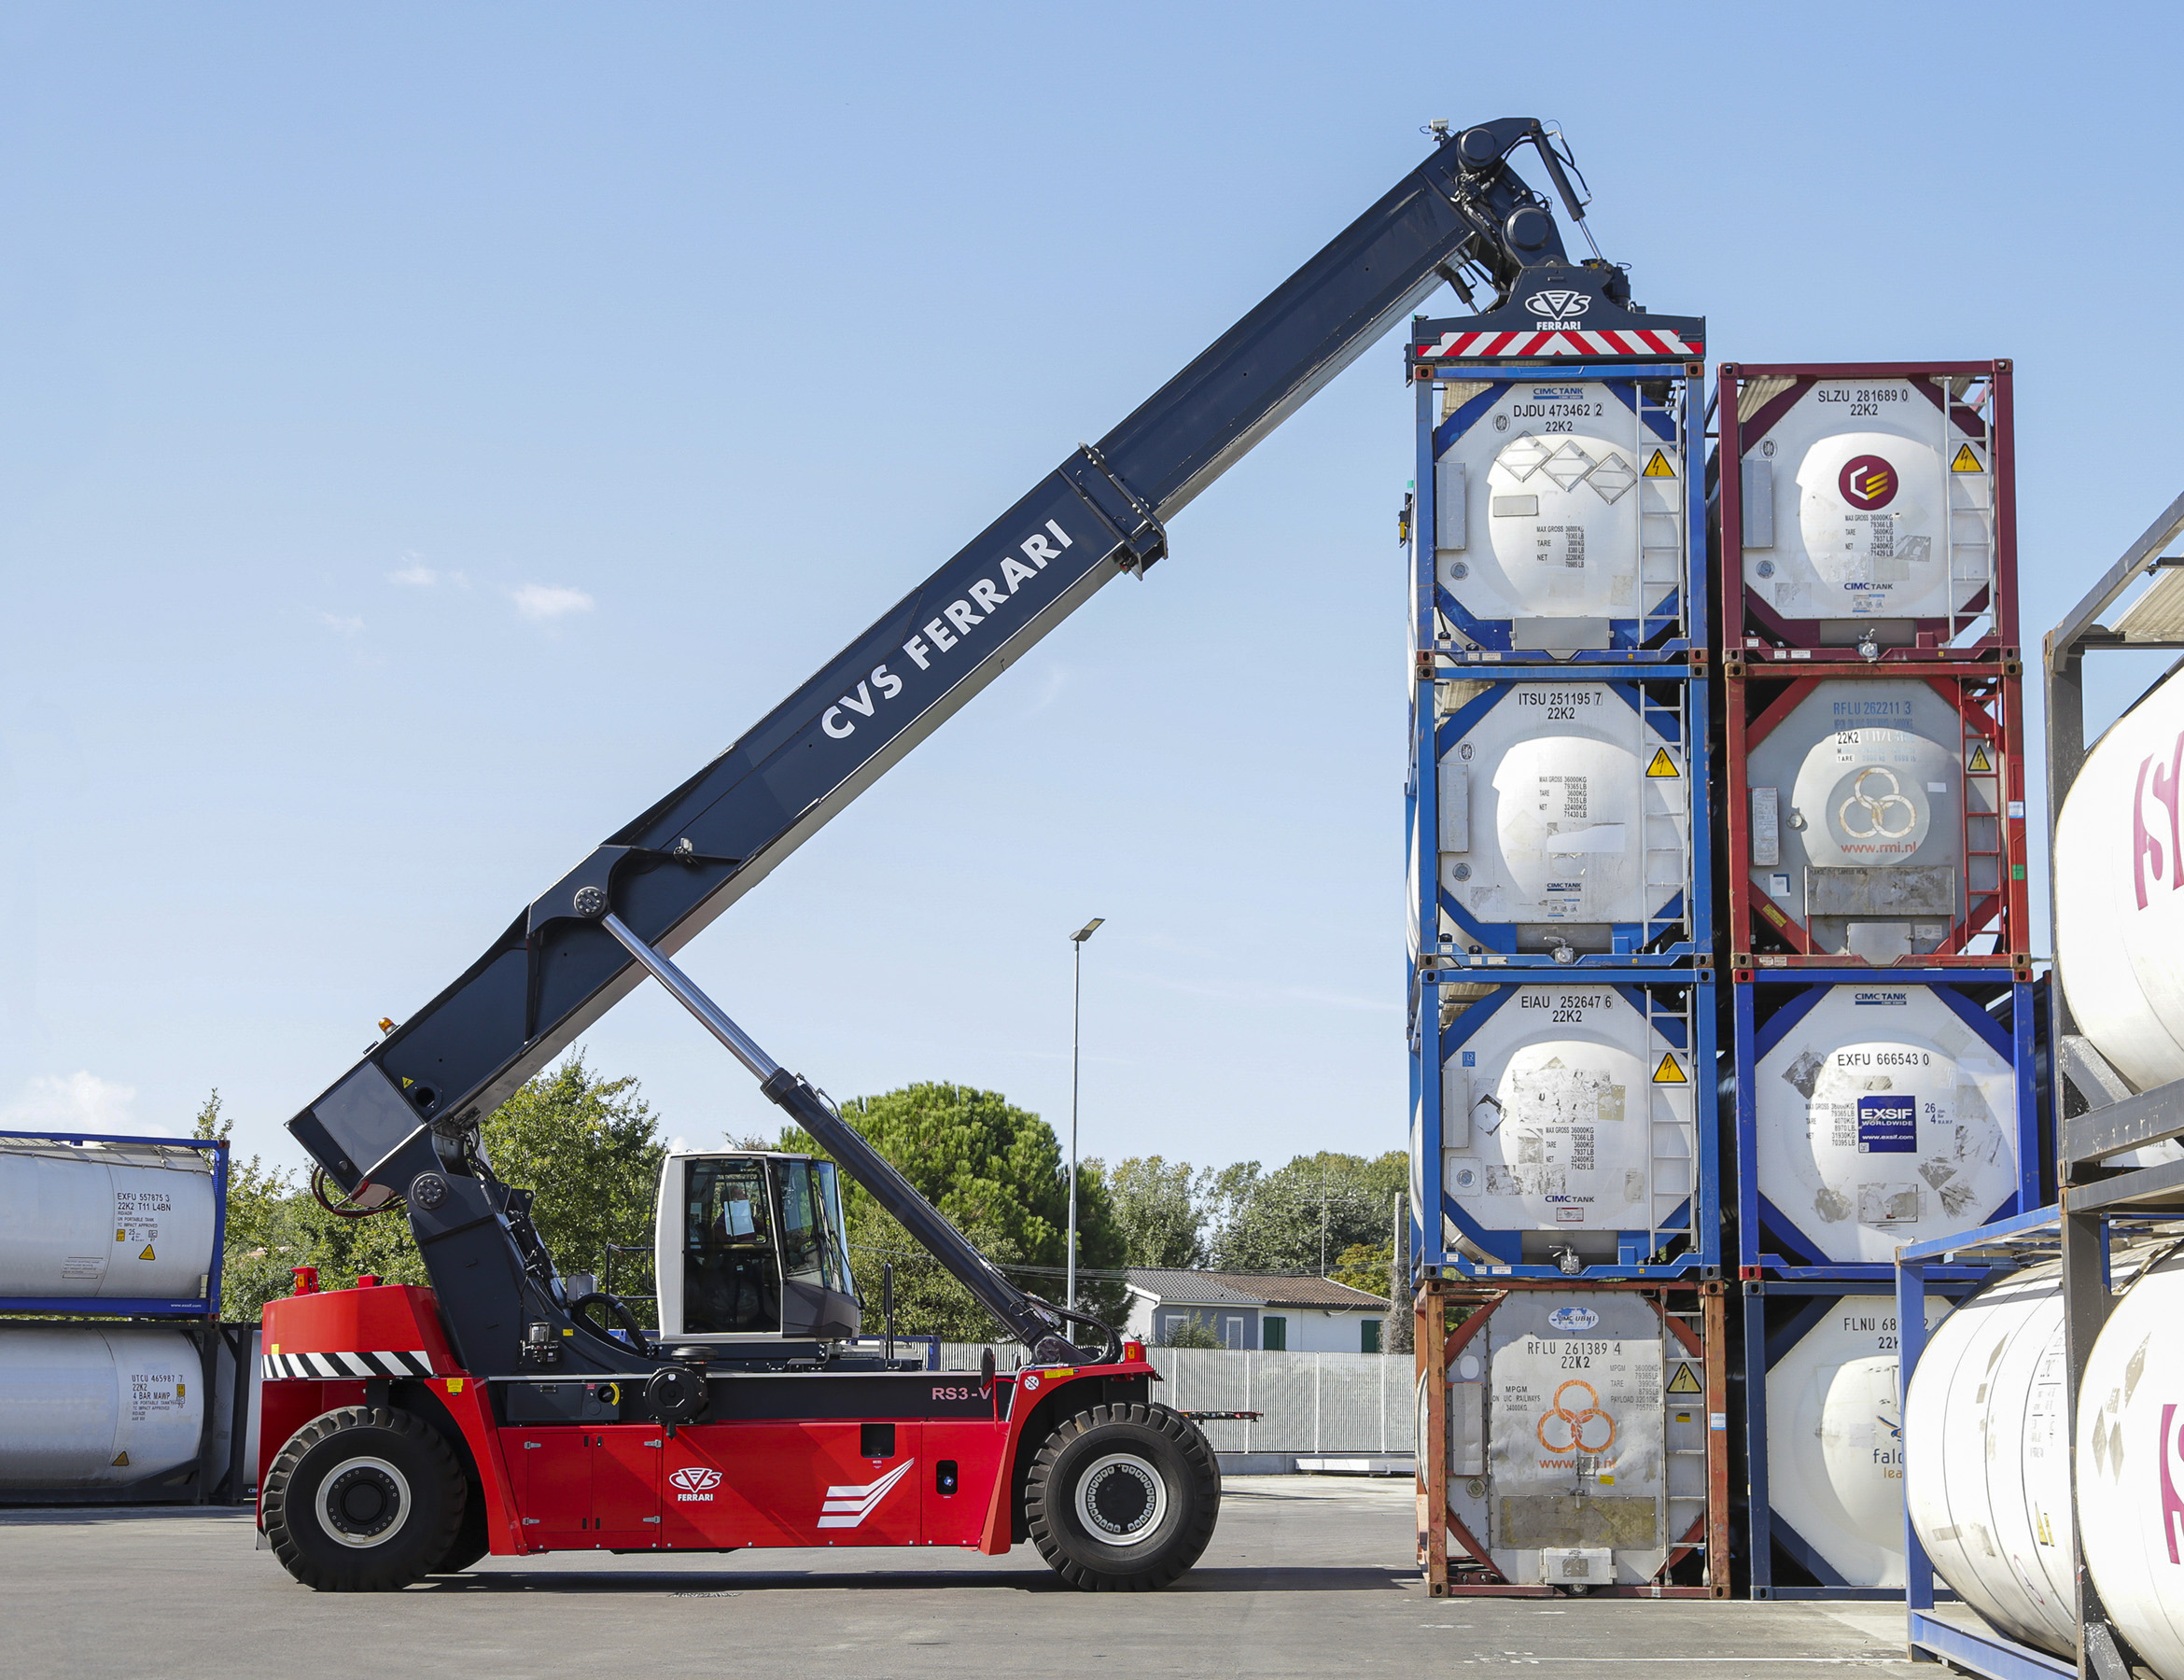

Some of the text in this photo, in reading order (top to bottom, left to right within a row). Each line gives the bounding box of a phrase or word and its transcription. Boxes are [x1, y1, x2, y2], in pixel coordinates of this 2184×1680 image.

[1525, 290, 1591, 320] CVS
[1536, 321, 1581, 330] FERRARI
[1818, 390, 1850, 402] SLZU
[1856, 390, 1897, 402] 281689
[1514, 404, 1602, 417] DJDU 473462 2
[1850, 404, 1878, 416] 22K2
[1546, 422, 1573, 432] 22K2
[821, 519, 1072, 738] CVS FERRARI
[1519, 693, 1602, 705] ITSU 251195 7
[1547, 707, 1575, 720] 22K2
[1833, 702, 1861, 715] RFLU
[1864, 702, 1899, 715] 262211
[1837, 732, 1859, 744] 22K2
[1841, 841, 1916, 853] www.rmi.nl
[1521, 996, 1611, 1008] EIAU 252647 6
[1552, 1010, 1582, 1022] 22K2
[1838, 1054, 1870, 1066] EXFU
[1877, 1054, 1918, 1065] 666543
[1925, 1102, 1936, 1113] 26
[1860, 1109, 1912, 1119] EXSIF
[1930, 1113, 1937, 1124] 4
[117, 1193, 136, 1201] EXFU
[139, 1193, 163, 1202] 557875
[118, 1202, 171, 1211] 22K2 T11 L4BN
[1844, 1318, 1875, 1331] FLNU
[1528, 1342, 1621, 1355] RFLU 261389 4
[1561, 1356, 1590, 1369] 22K2
[153, 1392, 171, 1400] MAWP
[1883, 1467, 1903, 1478] lea
[669, 1467, 723, 1493] CVS
